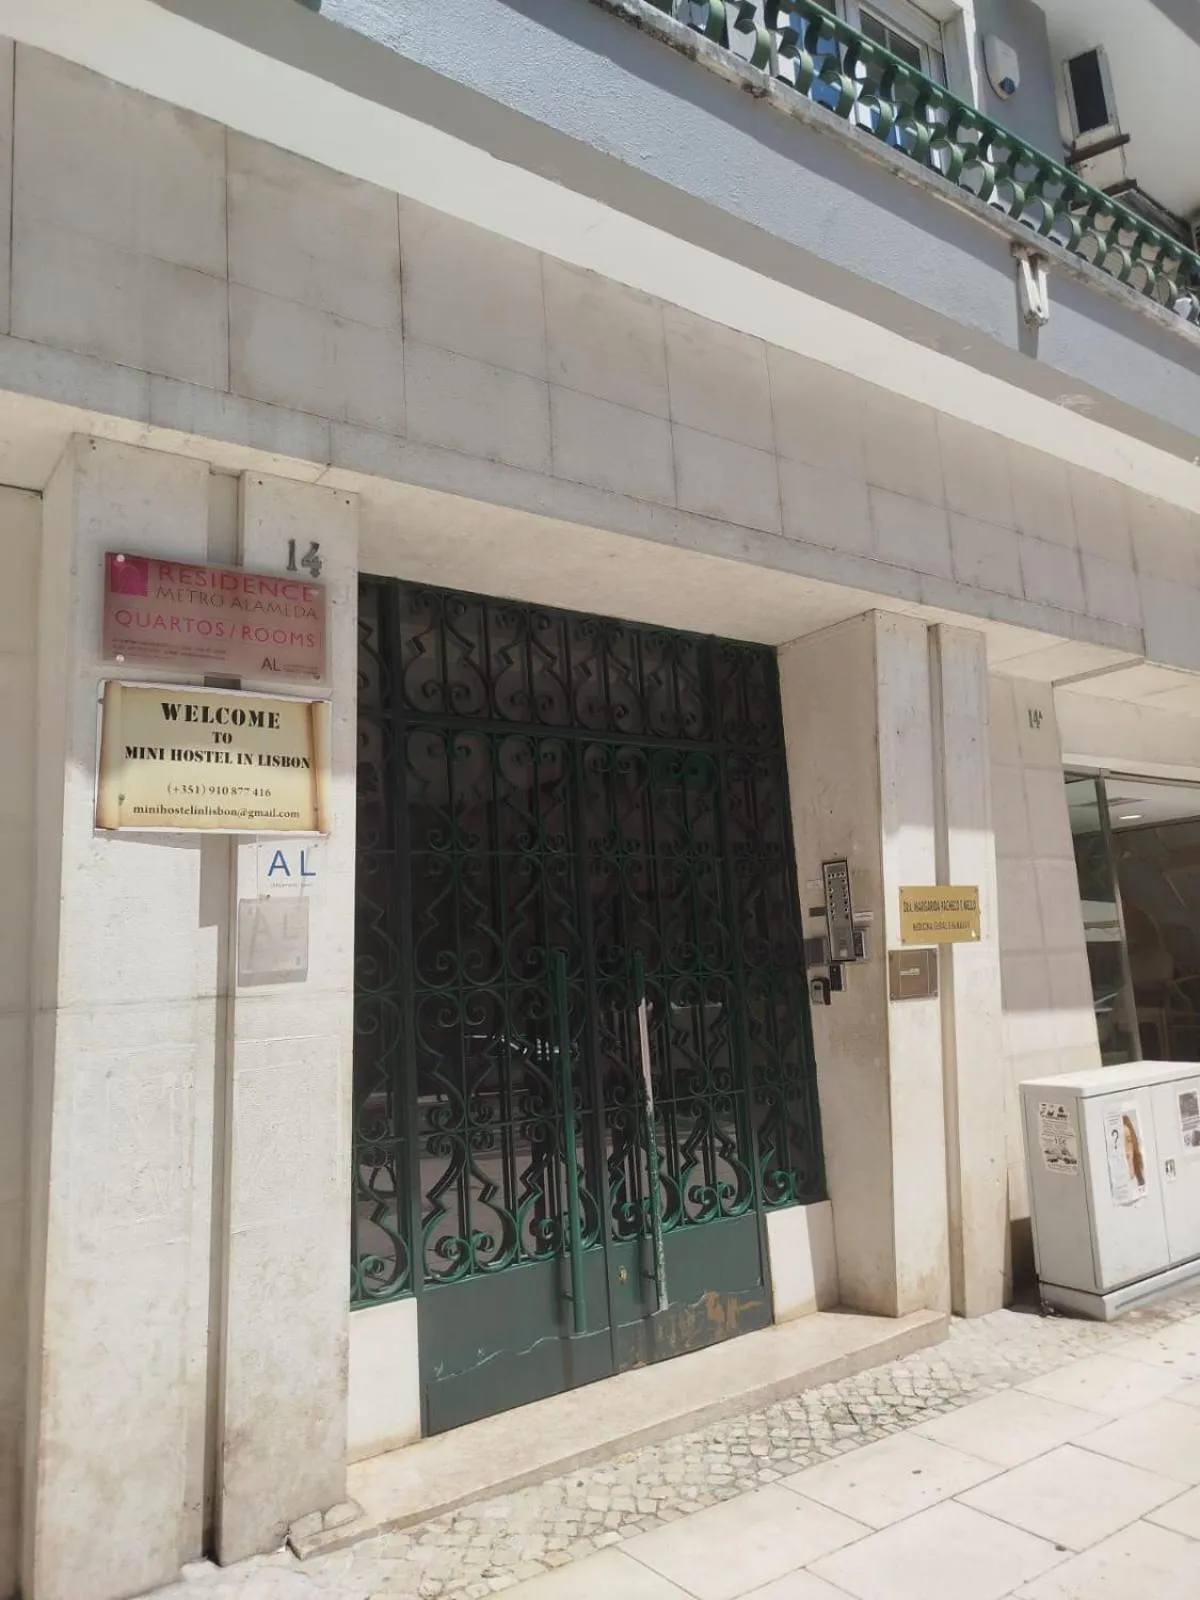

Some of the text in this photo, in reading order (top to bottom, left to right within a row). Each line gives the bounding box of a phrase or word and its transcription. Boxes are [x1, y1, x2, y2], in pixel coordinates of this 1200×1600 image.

[286, 538, 322, 578] 14
[158, 562, 315, 602] RESIDENCE
[156, 586, 224, 609] METRO
[261, 656, 282, 672] AL
[161, 702, 280, 730] WELCOME
[212, 731, 233, 744] TO
[124, 745, 311, 769] MINI HOSTEL IN LISBON
[167, 782, 206, 796] (+351)
[208, 784, 229, 796] 910
[252, 786, 272, 798] 416
[132, 803, 300, 820] minihostelinlisbon@gmail.com
